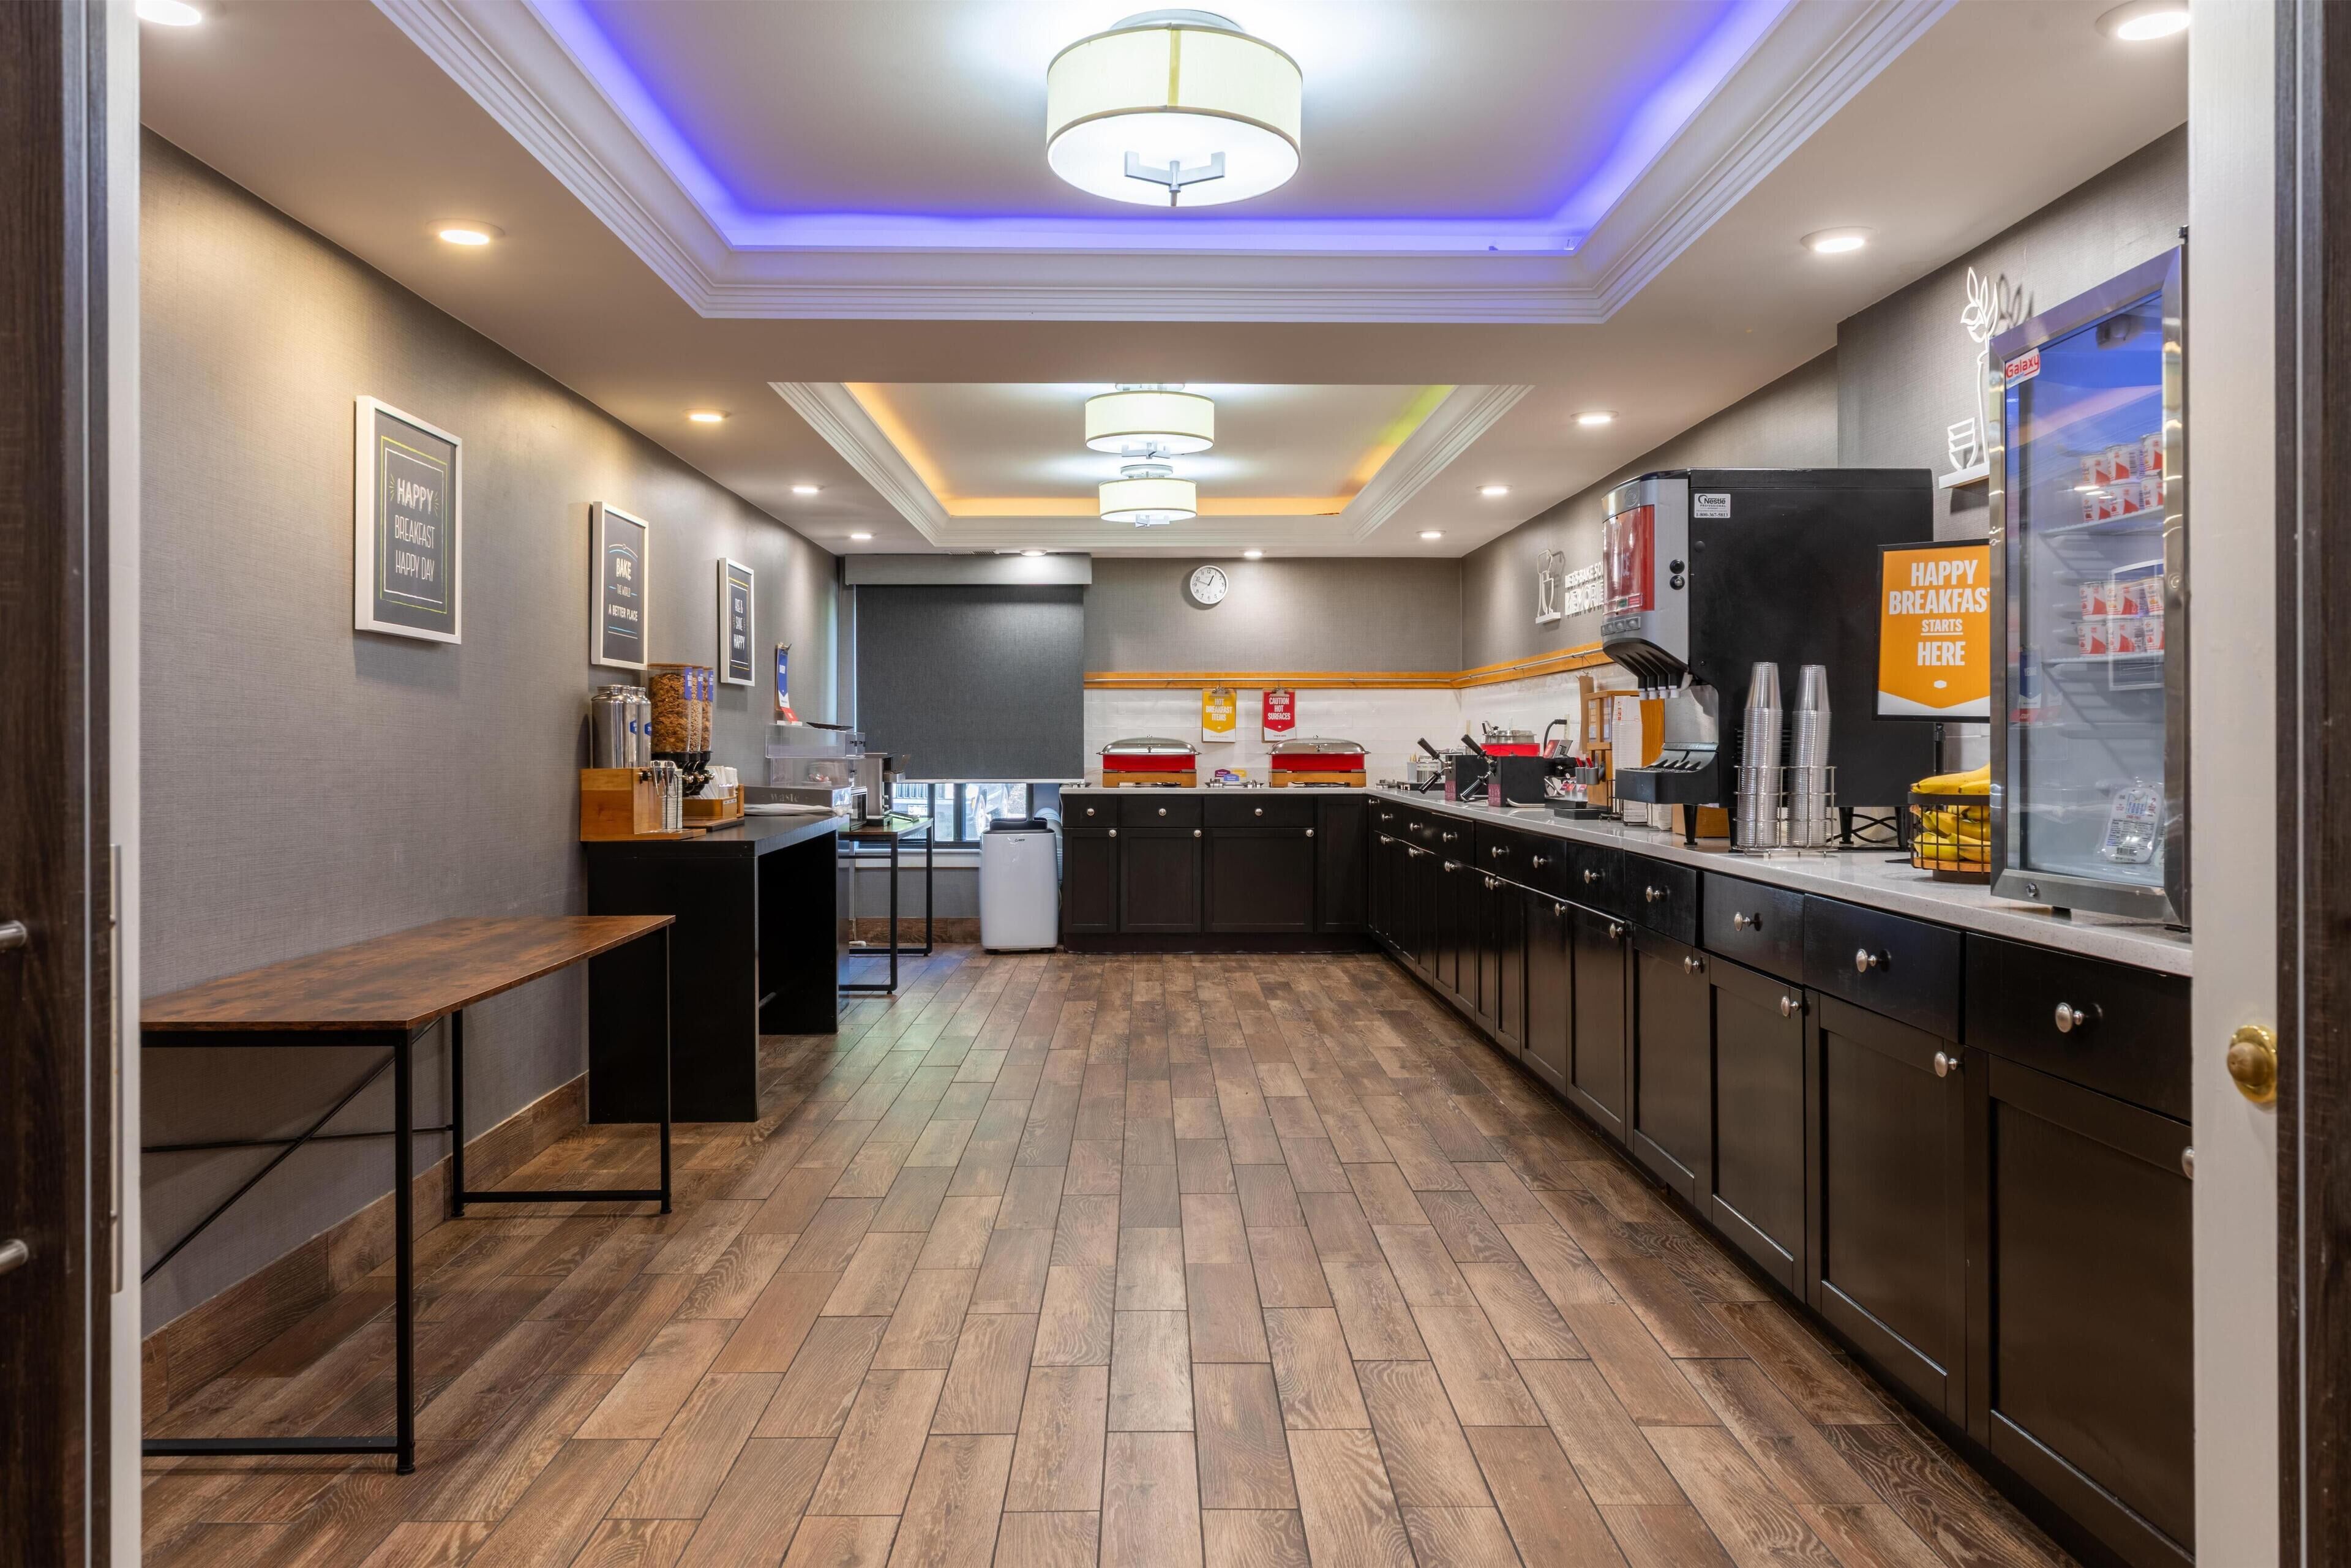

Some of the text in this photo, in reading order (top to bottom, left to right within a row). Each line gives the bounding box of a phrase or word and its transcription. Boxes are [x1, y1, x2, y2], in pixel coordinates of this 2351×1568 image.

[2006, 354, 2039, 378] Galaxy
[397, 478, 433, 514] HAPPY
[395, 515, 435, 549] BREAKFAST
[396, 550, 435, 582] HAPPY DAY
[616, 558, 631, 580] BAKE
[1580, 565, 1594, 583] BAKE
[1911, 560, 1978, 587] HAPPY
[608, 604, 638, 622] A BETTER PLACE
[1889, 587, 1990, 615] BREAKFAS
[1921, 619, 1963, 632] STARTS
[1917, 641, 1966, 666] HERE
[1205, 705, 1232, 714] BREAKFAST
